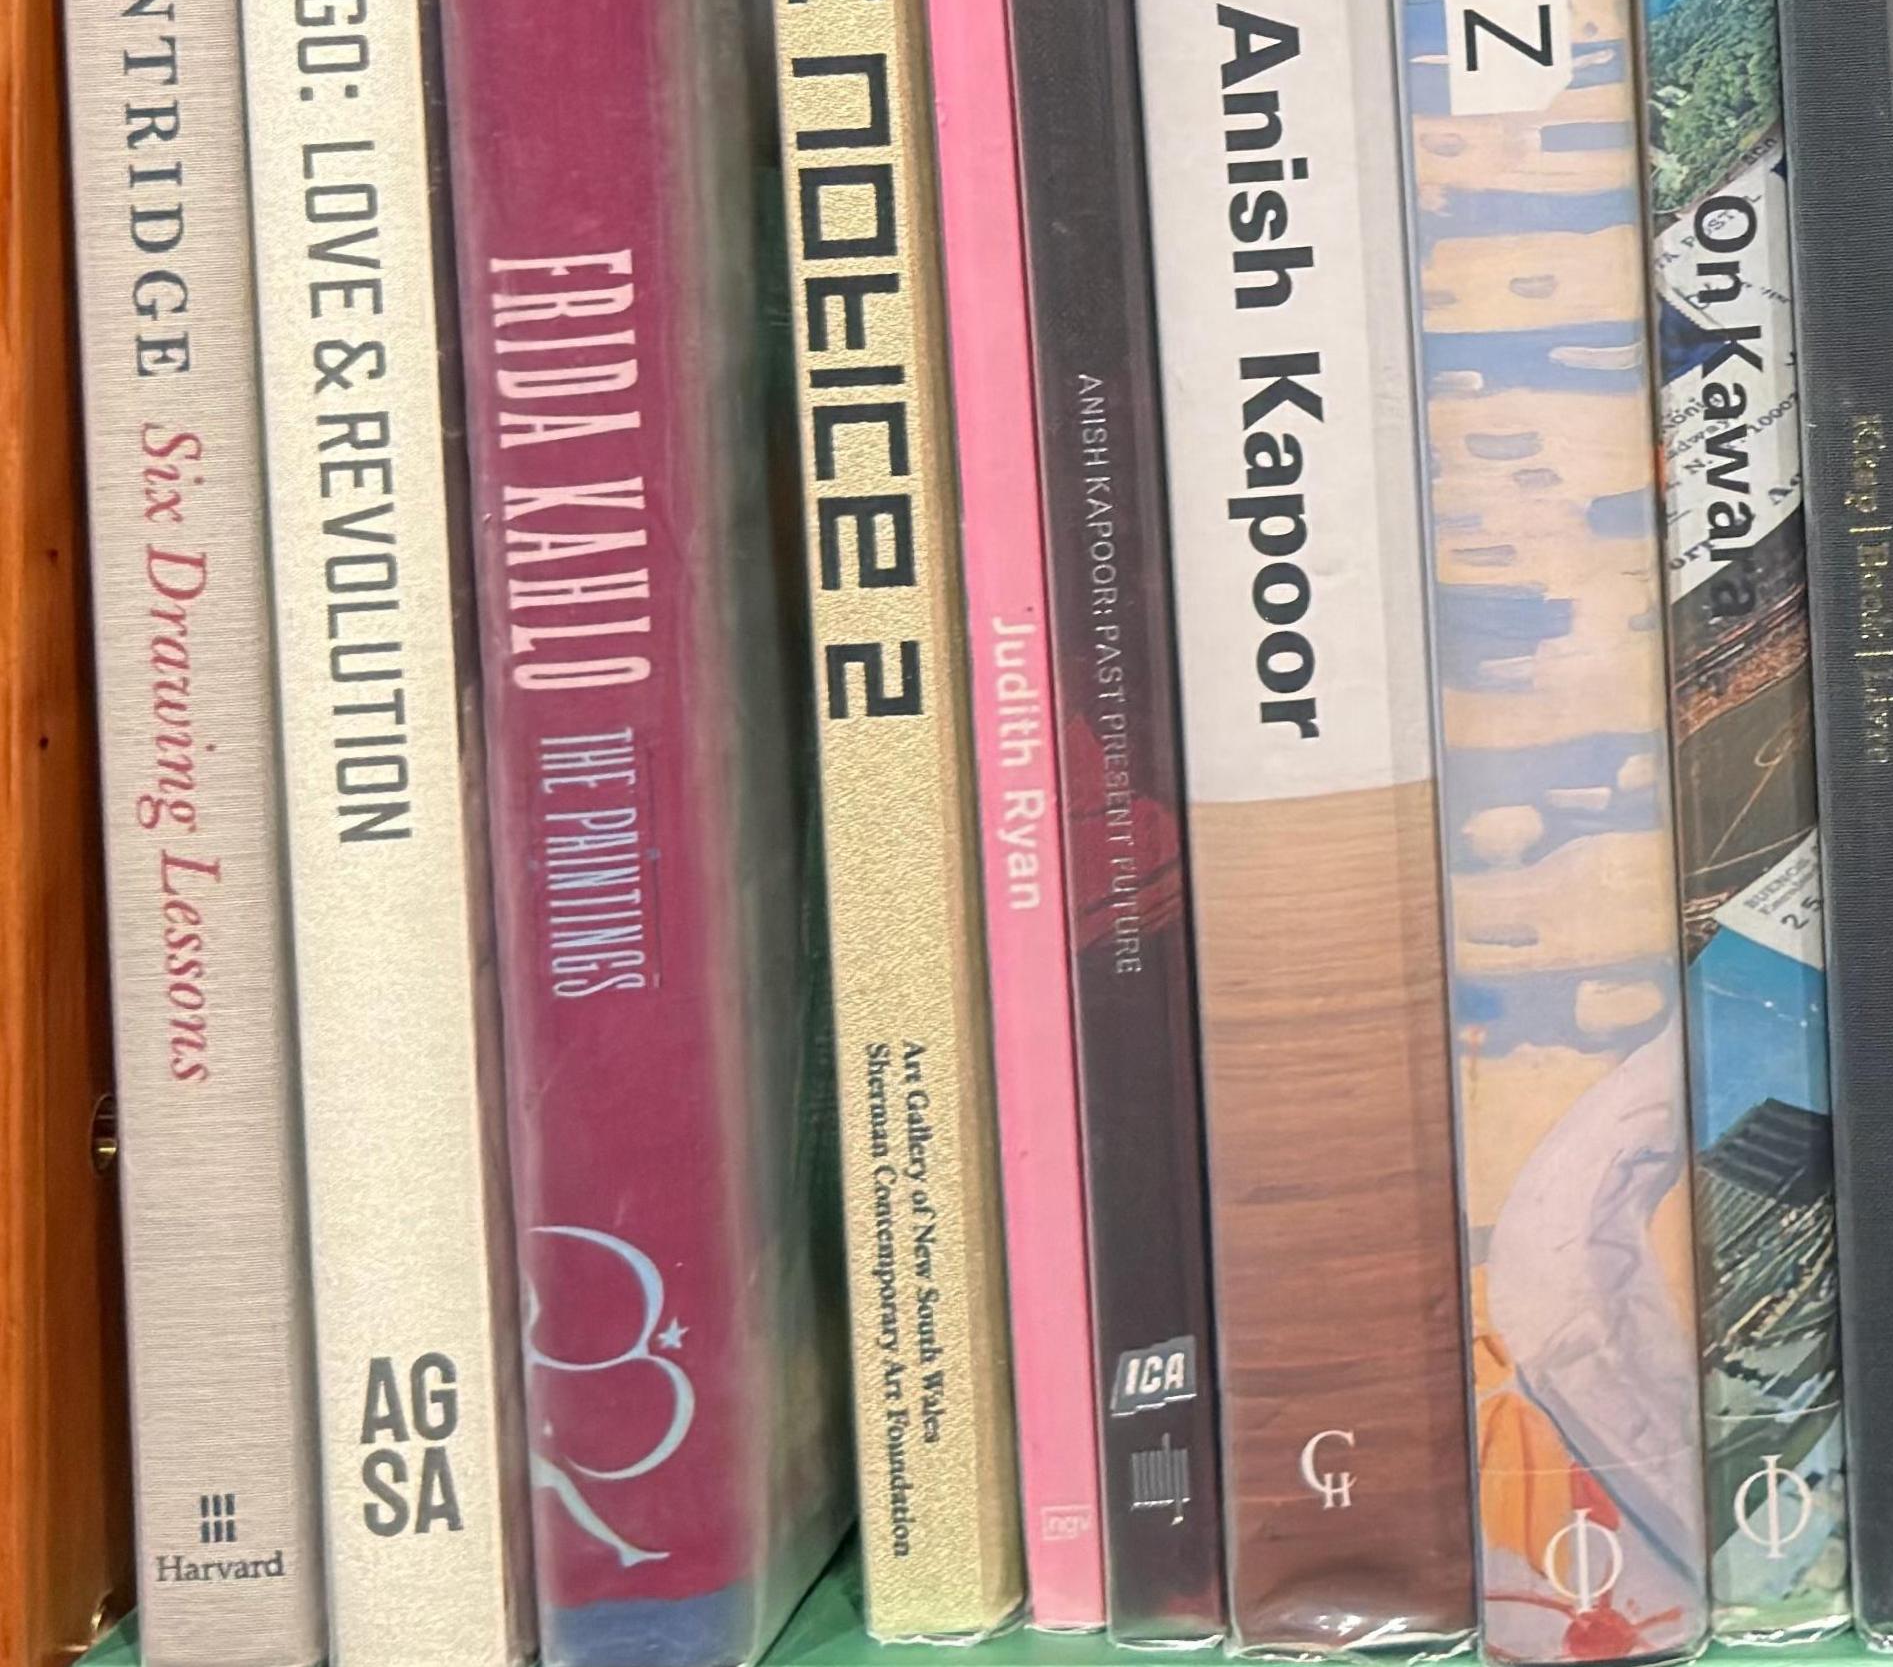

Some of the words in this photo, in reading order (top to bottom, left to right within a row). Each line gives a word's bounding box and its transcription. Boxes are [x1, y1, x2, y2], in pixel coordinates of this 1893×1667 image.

[1216, 2, 1315, 310] Anish
[301, 139, 385, 319] LOVE
[1693, 195, 1758, 303] On
[313, 338, 387, 394] &
[490, 249, 641, 450] FRIDA
[140, 420, 206, 524] Six
[1079, 372, 1113, 466] ANISH
[1699, 325, 1764, 618] Kawara
[502, 475, 652, 690] KAHLO
[1228, 351, 1324, 741] Kapoor
[316, 409, 413, 844] REVOLUTION
[826, 639, 923, 720] 2
[1095, 624, 1128, 714] PAST
[136, 543, 217, 833] Drawing
[993, 615, 1045, 769] Judith
[540, 726, 636, 794] THE
[1102, 718, 1135, 845] PRESENT
[545, 806, 646, 998] PAINTINGS
[1004, 787, 1046, 911] Ryan
[159, 848, 221, 1083] Lessons
[1111, 853, 1143, 976] FUTURE
[866, 1041, 888, 1158] Sherman
[902, 1041, 925, 1082] Art
[905, 1088, 931, 1184] Gallery
[871, 1162, 899, 1353] Contemporary
[912, 1190, 934, 1219] of
[914, 1224, 937, 1276] New
[917, 1285, 941, 1363] South
[1124, 1351, 1187, 1396] ICA
[360, 1351, 458, 1444] AG
[883, 1358, 905, 1400] Art
[922, 1369, 944, 1444] Wales
[361, 1444, 464, 1538] SA
[886, 1407, 915, 1558] Foundation
[156, 1551, 286, 1583] Harvard
